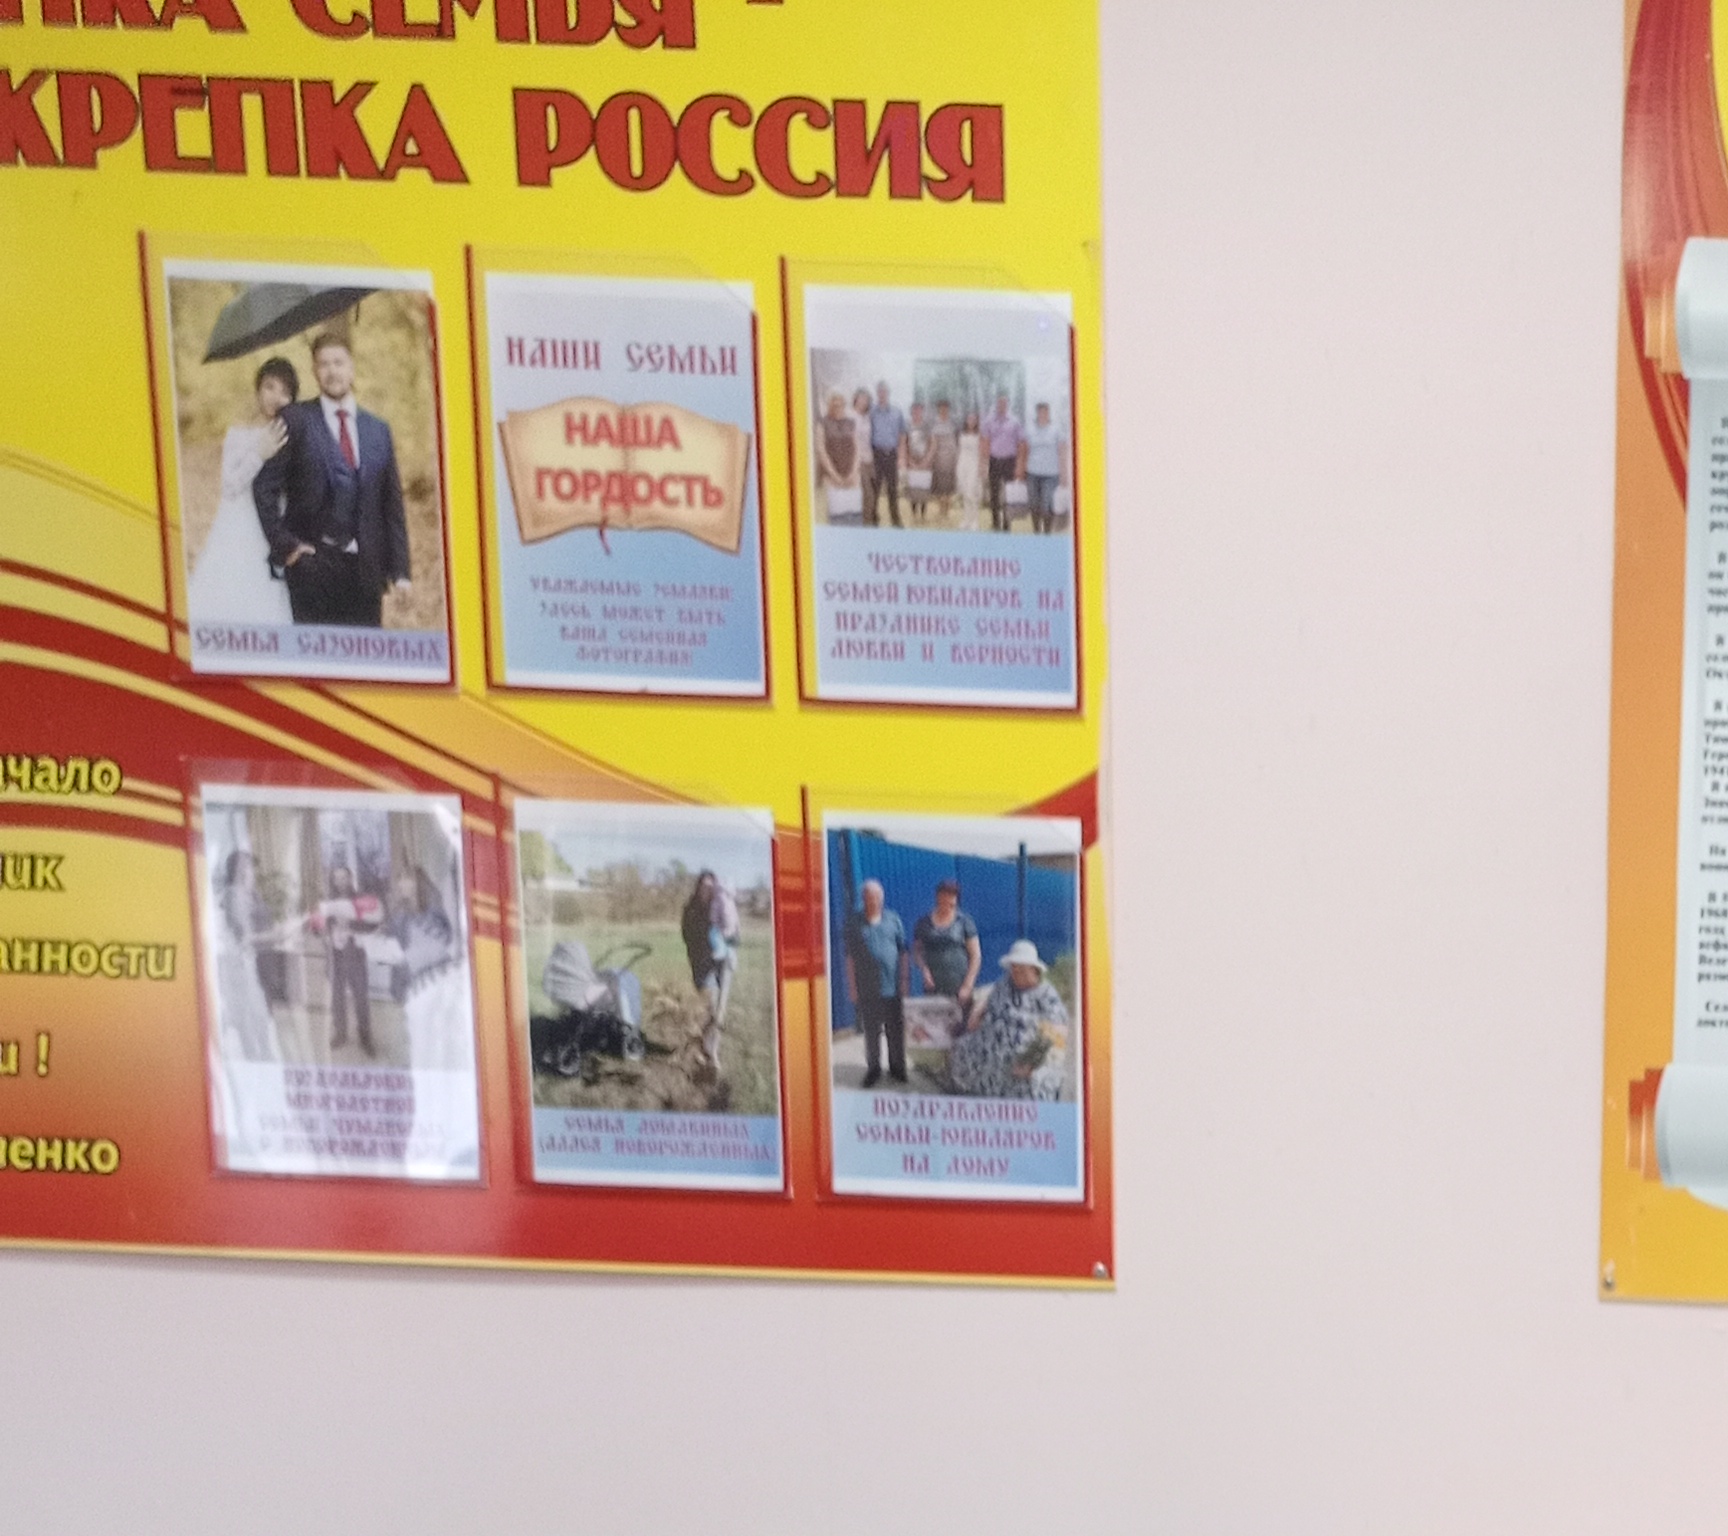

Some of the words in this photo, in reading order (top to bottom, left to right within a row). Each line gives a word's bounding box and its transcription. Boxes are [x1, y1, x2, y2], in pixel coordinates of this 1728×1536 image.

[0, 67, 471, 184] КРЕПКА
[512, 87, 1006, 203] РОССИЯ
[506, 336, 601, 370] НАШИ
[625, 341, 738, 376] СЕМЬИ
[564, 411, 683, 452] НАША
[534, 467, 725, 513] ГОРДОСТЬ
